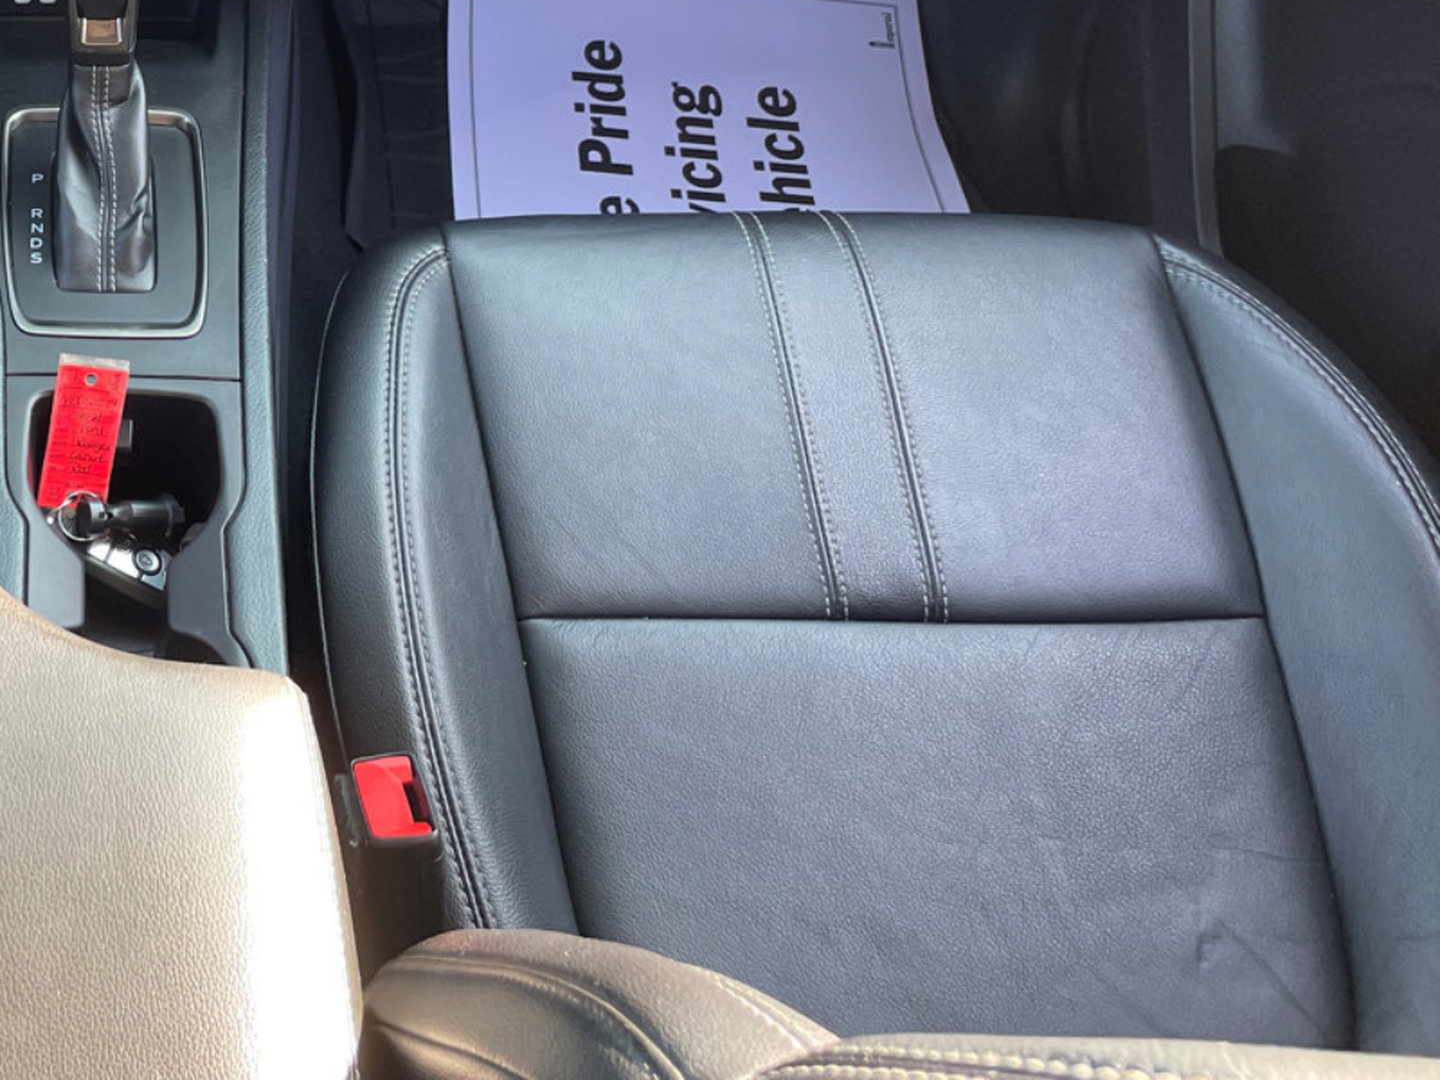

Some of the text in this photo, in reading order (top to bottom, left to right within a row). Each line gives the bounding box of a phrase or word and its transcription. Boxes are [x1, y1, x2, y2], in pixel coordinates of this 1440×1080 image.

[571, 38, 634, 176] Pride
[746, 86, 816, 212] hicle
[31, 172, 44, 184] P
[31, 207, 44, 219] R
[30, 222, 44, 234] N
[29, 237, 43, 249] D
[30, 251, 43, 264] S
